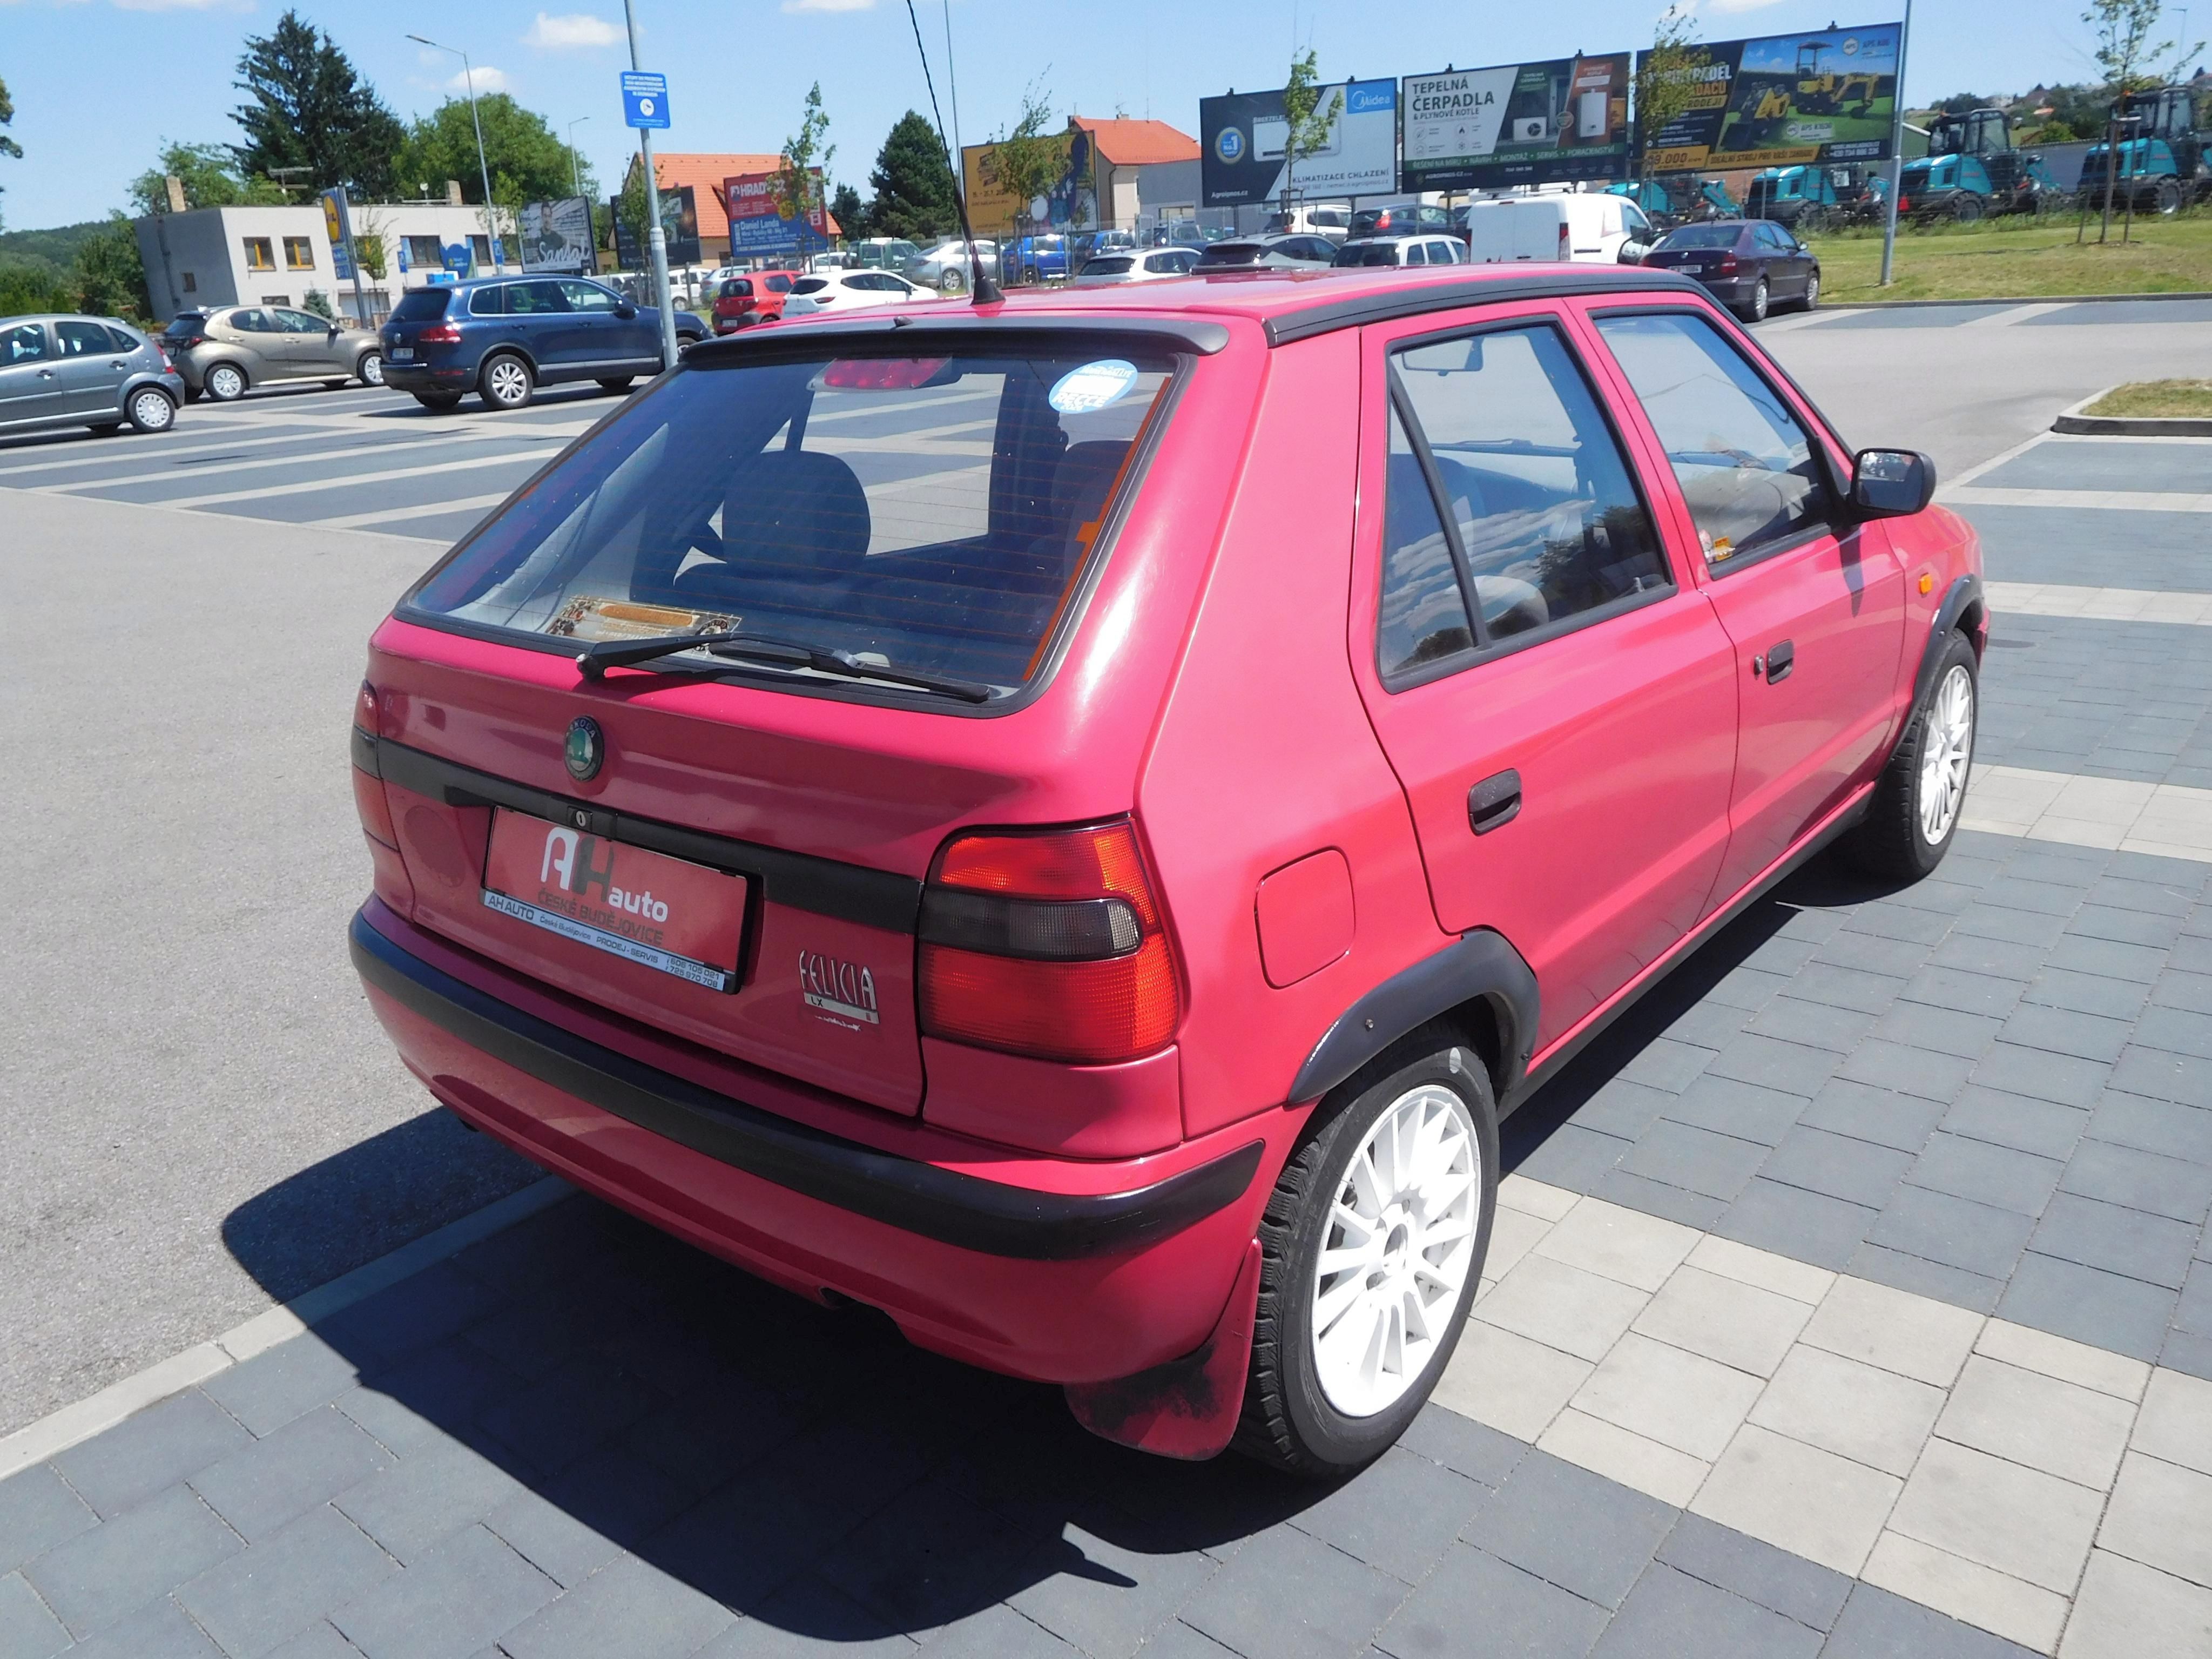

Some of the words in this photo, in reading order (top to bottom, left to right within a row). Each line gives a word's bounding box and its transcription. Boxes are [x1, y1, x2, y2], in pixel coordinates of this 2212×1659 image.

[1412, 76, 1468, 94] TEPELNÁ
[1412, 91, 1494, 111] ČERPADLA
[1420, 109, 1453, 120] PLYNOVÉ
[1456, 107, 1479, 116] KOTLE
[1292, 172, 1345, 183] KLIMATIZACE
[1348, 168, 1389, 179] CHLAZENÍ
[740, 219, 759, 230] Daniel
[1052, 392, 1110, 408] RECCE
[538, 887, 576, 916] ČESKÉ
[579, 905, 664, 946] BUDĚJOVICE
[488, 895, 504, 909] AH
[504, 901, 535, 921] AUTO
[540, 914, 558, 928] České
[596, 936, 626, 952] PRODEJ
[631, 949, 658, 963] SERVIS
[686, 972, 701, 982] 970
[799, 950, 877, 1011] FELICIA
[811, 996, 823, 1007] LX
